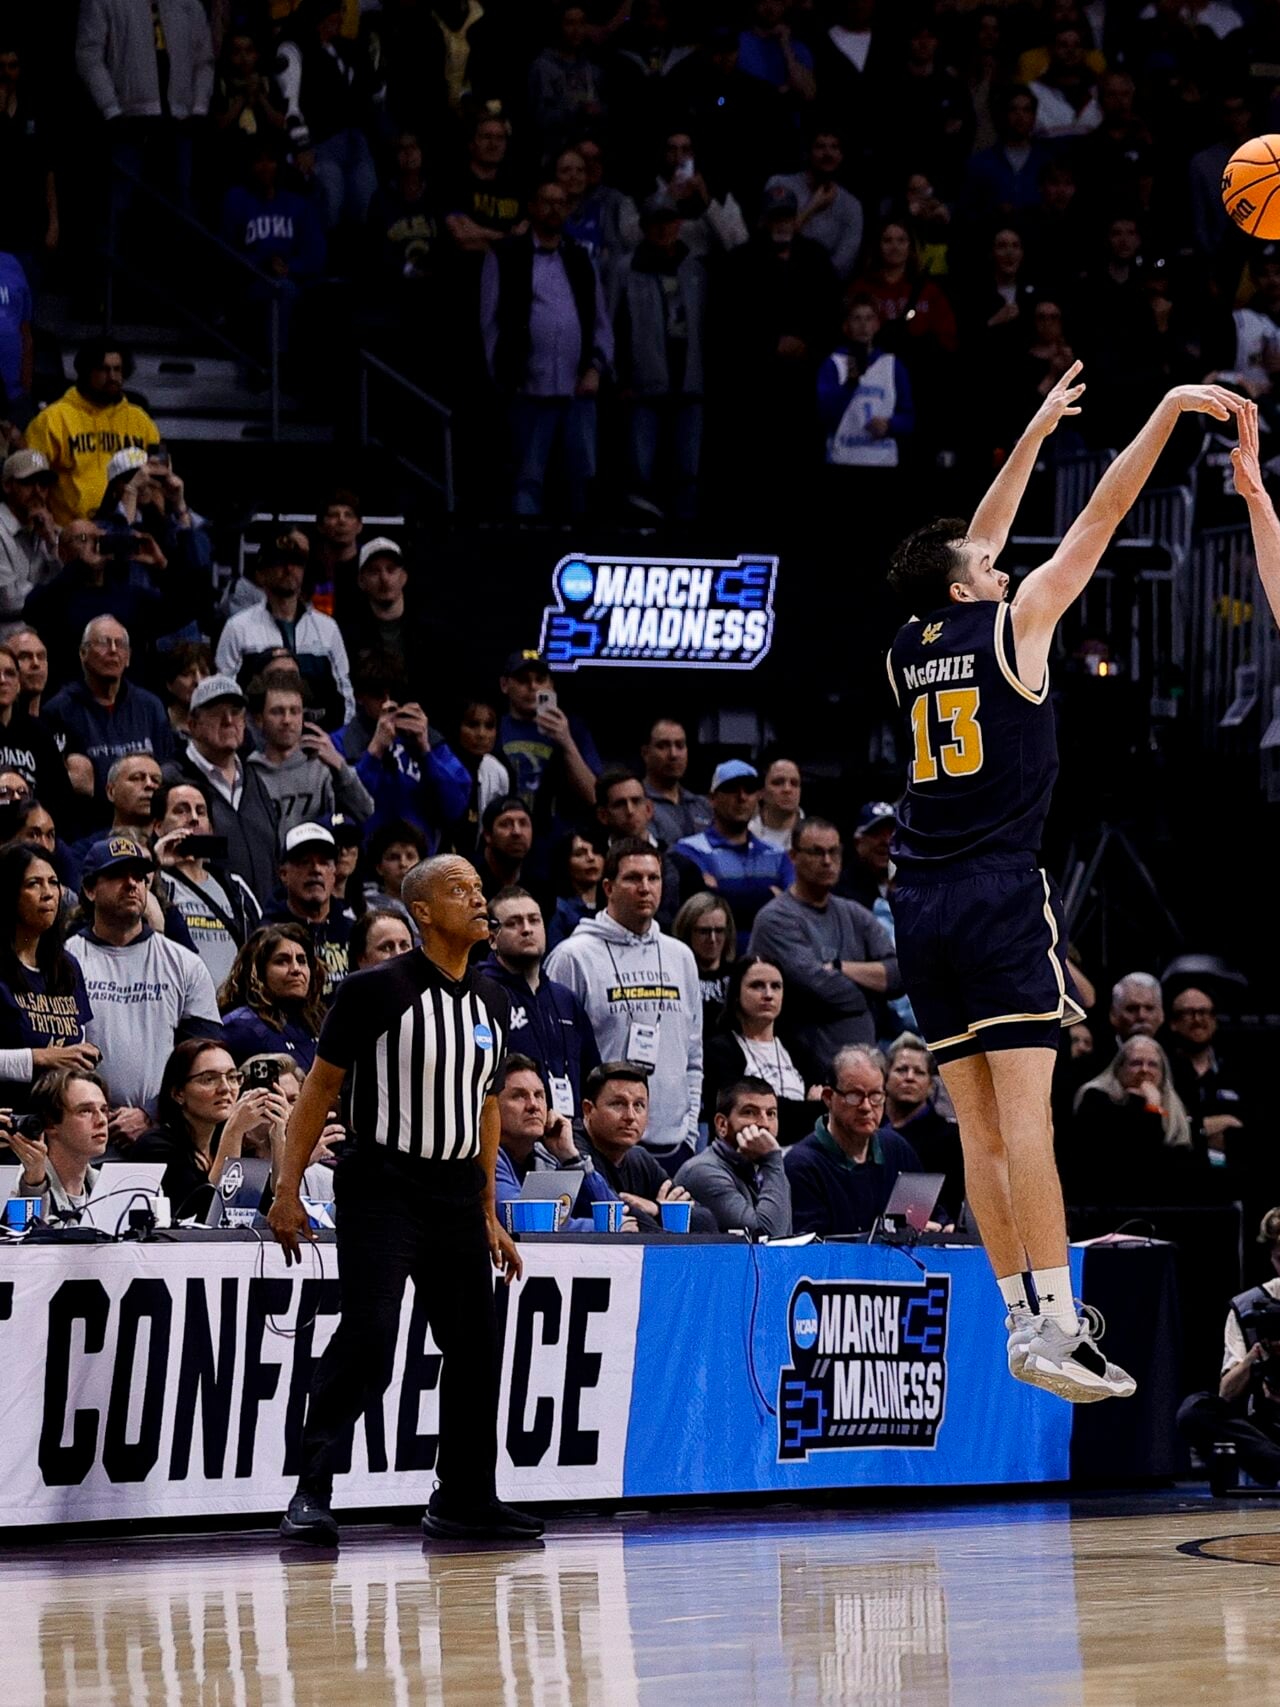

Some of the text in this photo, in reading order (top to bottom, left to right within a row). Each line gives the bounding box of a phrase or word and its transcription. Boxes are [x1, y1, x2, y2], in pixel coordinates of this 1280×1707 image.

[594, 565, 713, 609] MARCH
[607, 606, 769, 651] MADNESS
[903, 653, 976, 691] McGHIE
[911, 686, 984, 784] 13
[28, 1011, 79, 1037] TRITONS
[817, 1294, 900, 1356] MARCH
[37, 1276, 612, 1487] CONFEECE
[832, 1360, 943, 1421] MADNESS
